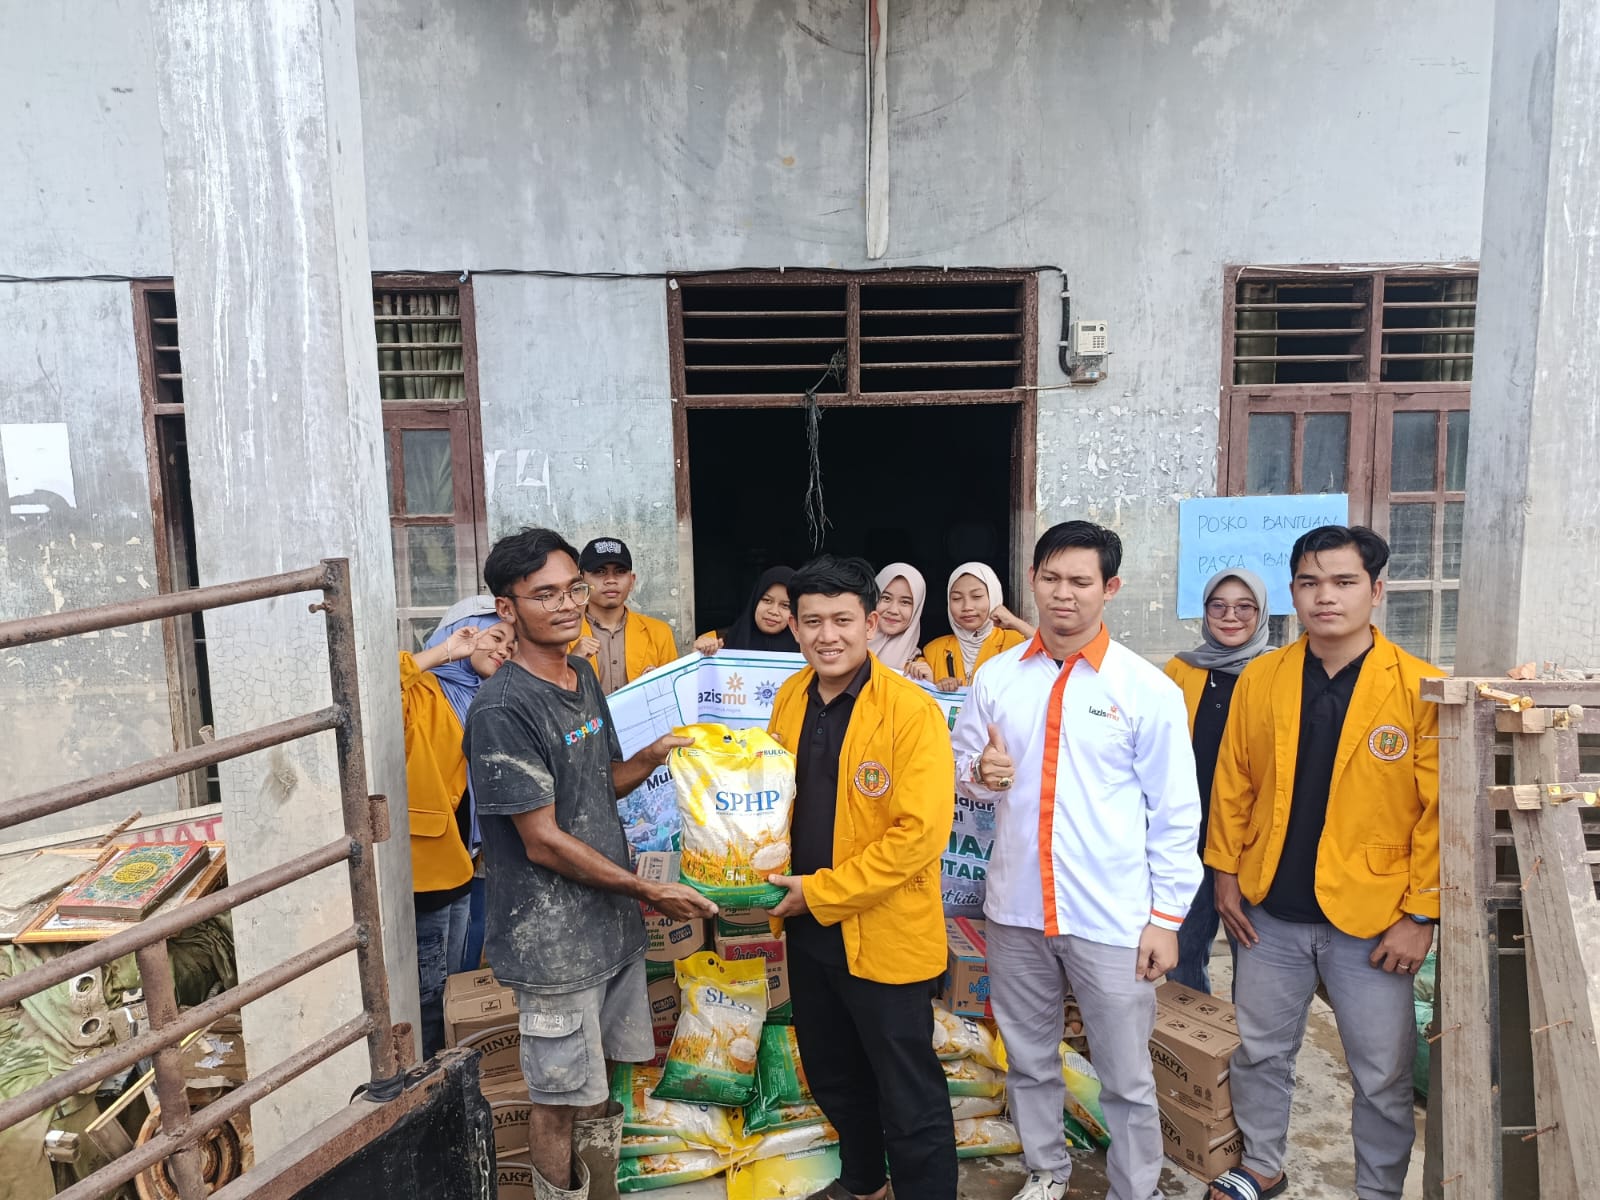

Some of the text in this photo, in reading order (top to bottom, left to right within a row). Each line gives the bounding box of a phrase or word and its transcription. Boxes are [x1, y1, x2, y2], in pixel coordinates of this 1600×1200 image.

[1198, 515, 1248, 539] POSKO
[1198, 551, 1291, 575] PASCA BAN
[715, 790, 781, 813] SPHP
[726, 870, 734, 881] 5
[657, 917, 673, 927] 40
